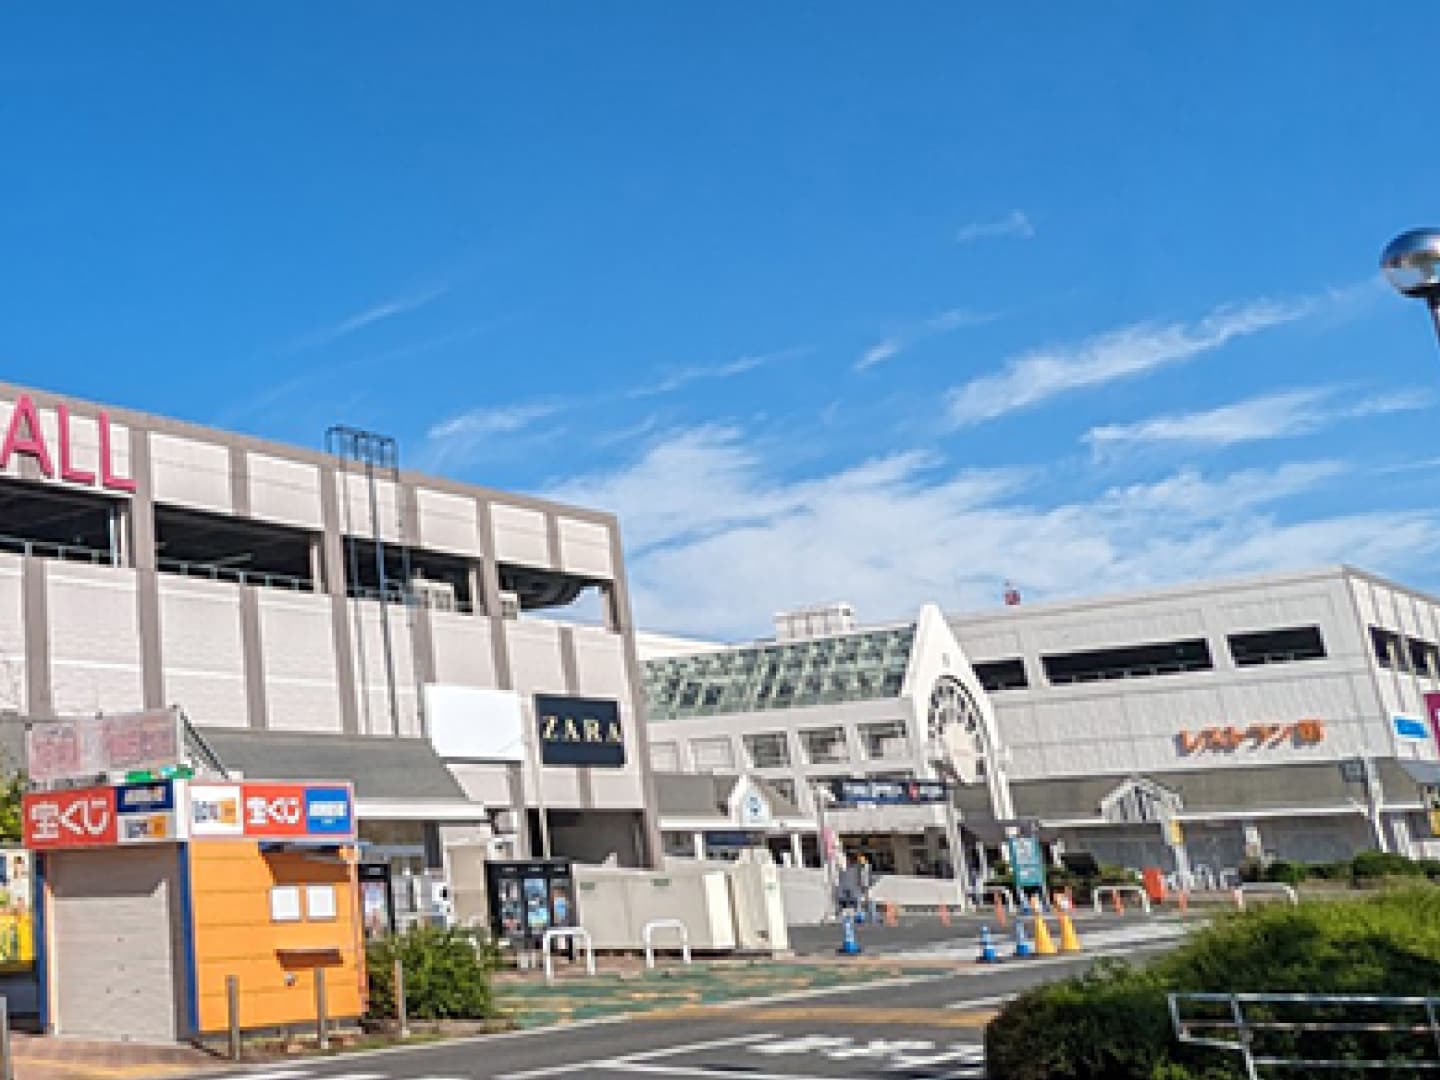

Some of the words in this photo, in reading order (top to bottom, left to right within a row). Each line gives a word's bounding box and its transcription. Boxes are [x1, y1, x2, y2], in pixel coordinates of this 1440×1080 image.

[542, 714, 622, 743] ZARA
[30, 798, 111, 842] 宝くじ
[245, 794, 301, 826] 宝くじ
